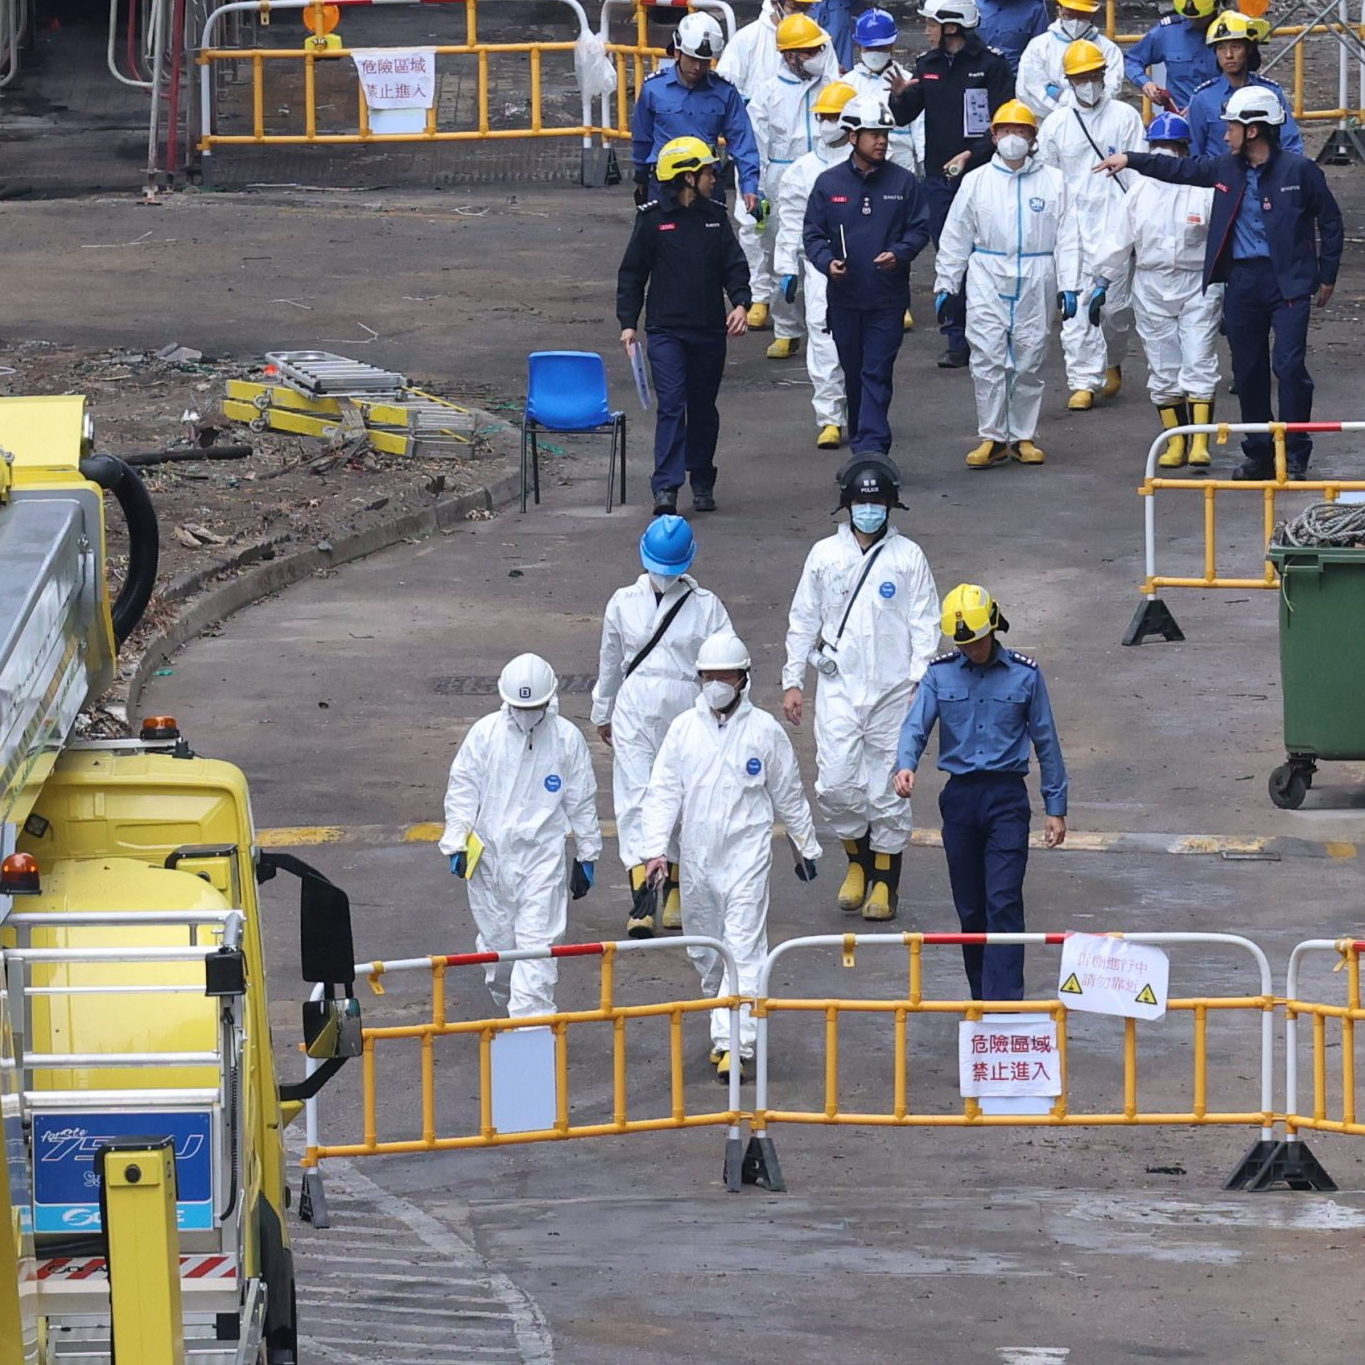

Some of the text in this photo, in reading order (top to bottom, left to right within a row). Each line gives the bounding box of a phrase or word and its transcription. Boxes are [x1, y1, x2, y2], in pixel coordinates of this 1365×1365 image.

[362, 57, 426, 74] 危險區域
[366, 83, 427, 99] 禁止進入
[971, 1034, 1052, 1054] 危險區域
[972, 1061, 1051, 1082] 禁止進入
